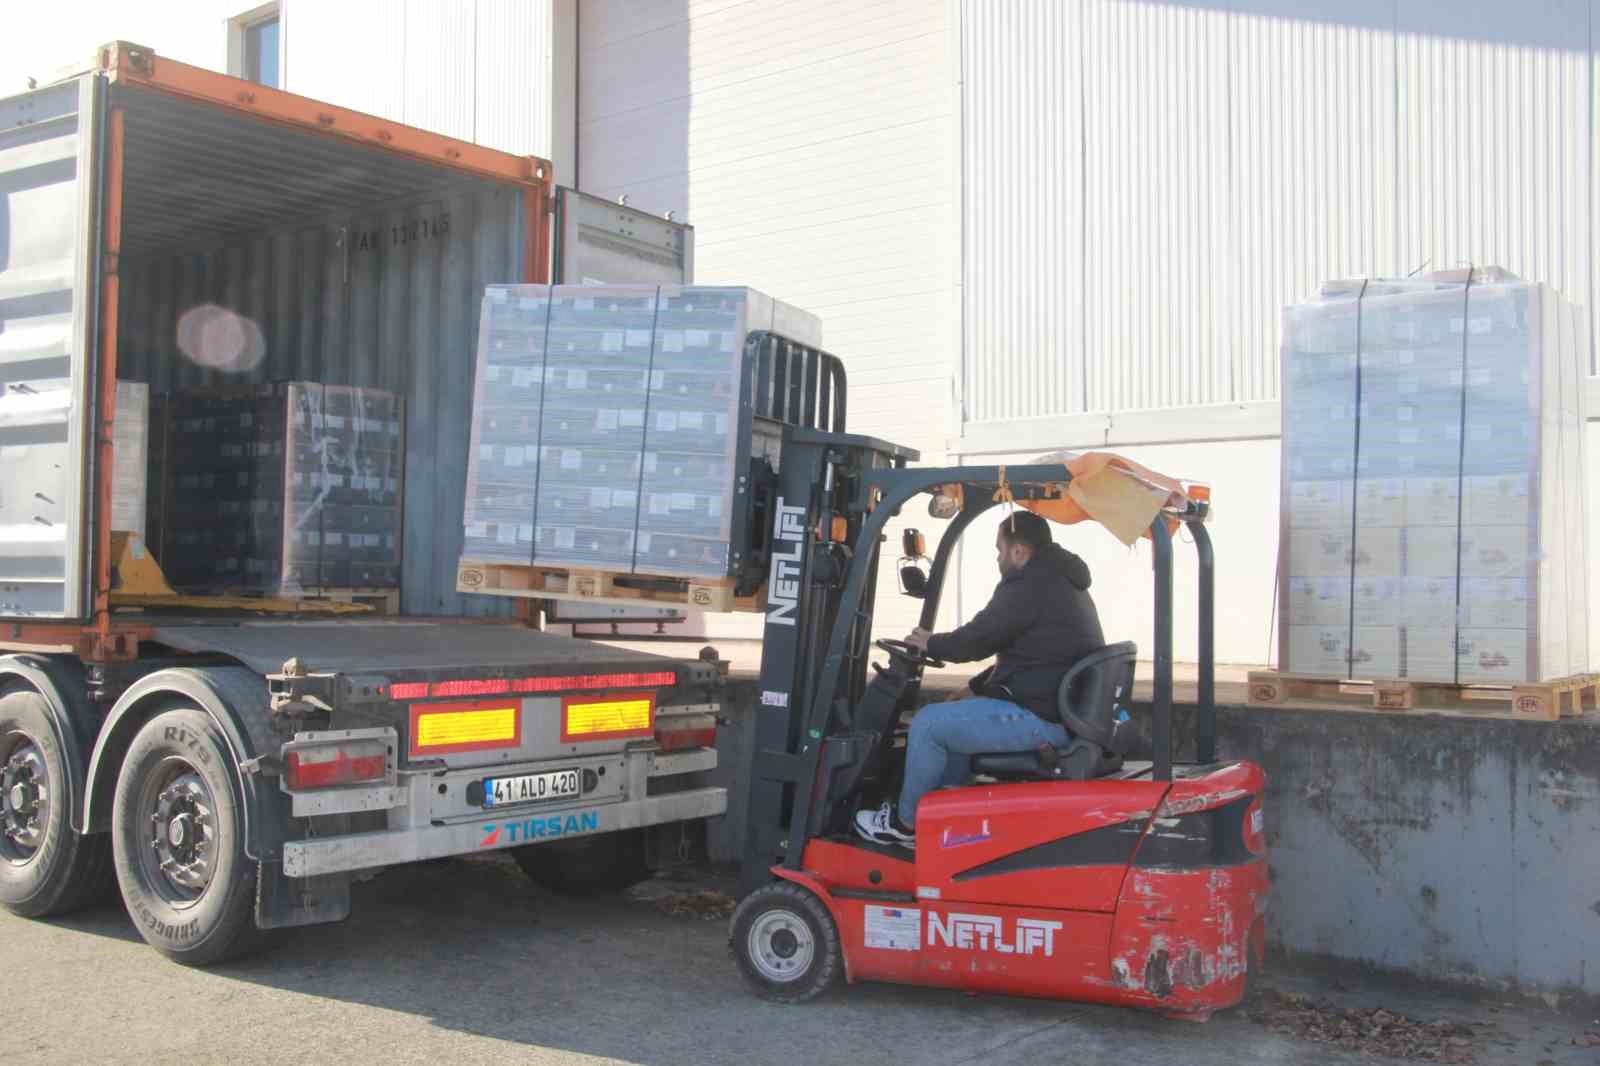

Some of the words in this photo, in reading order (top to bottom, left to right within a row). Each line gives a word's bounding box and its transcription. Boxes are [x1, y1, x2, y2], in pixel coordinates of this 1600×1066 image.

[766, 497, 806, 626] NETLIFT
[494, 780, 513, 801] 41
[520, 776, 547, 798] ALD
[551, 772, 577, 795] 420
[503, 811, 599, 842] TIRSAN
[927, 910, 1064, 958] NETLIFT
